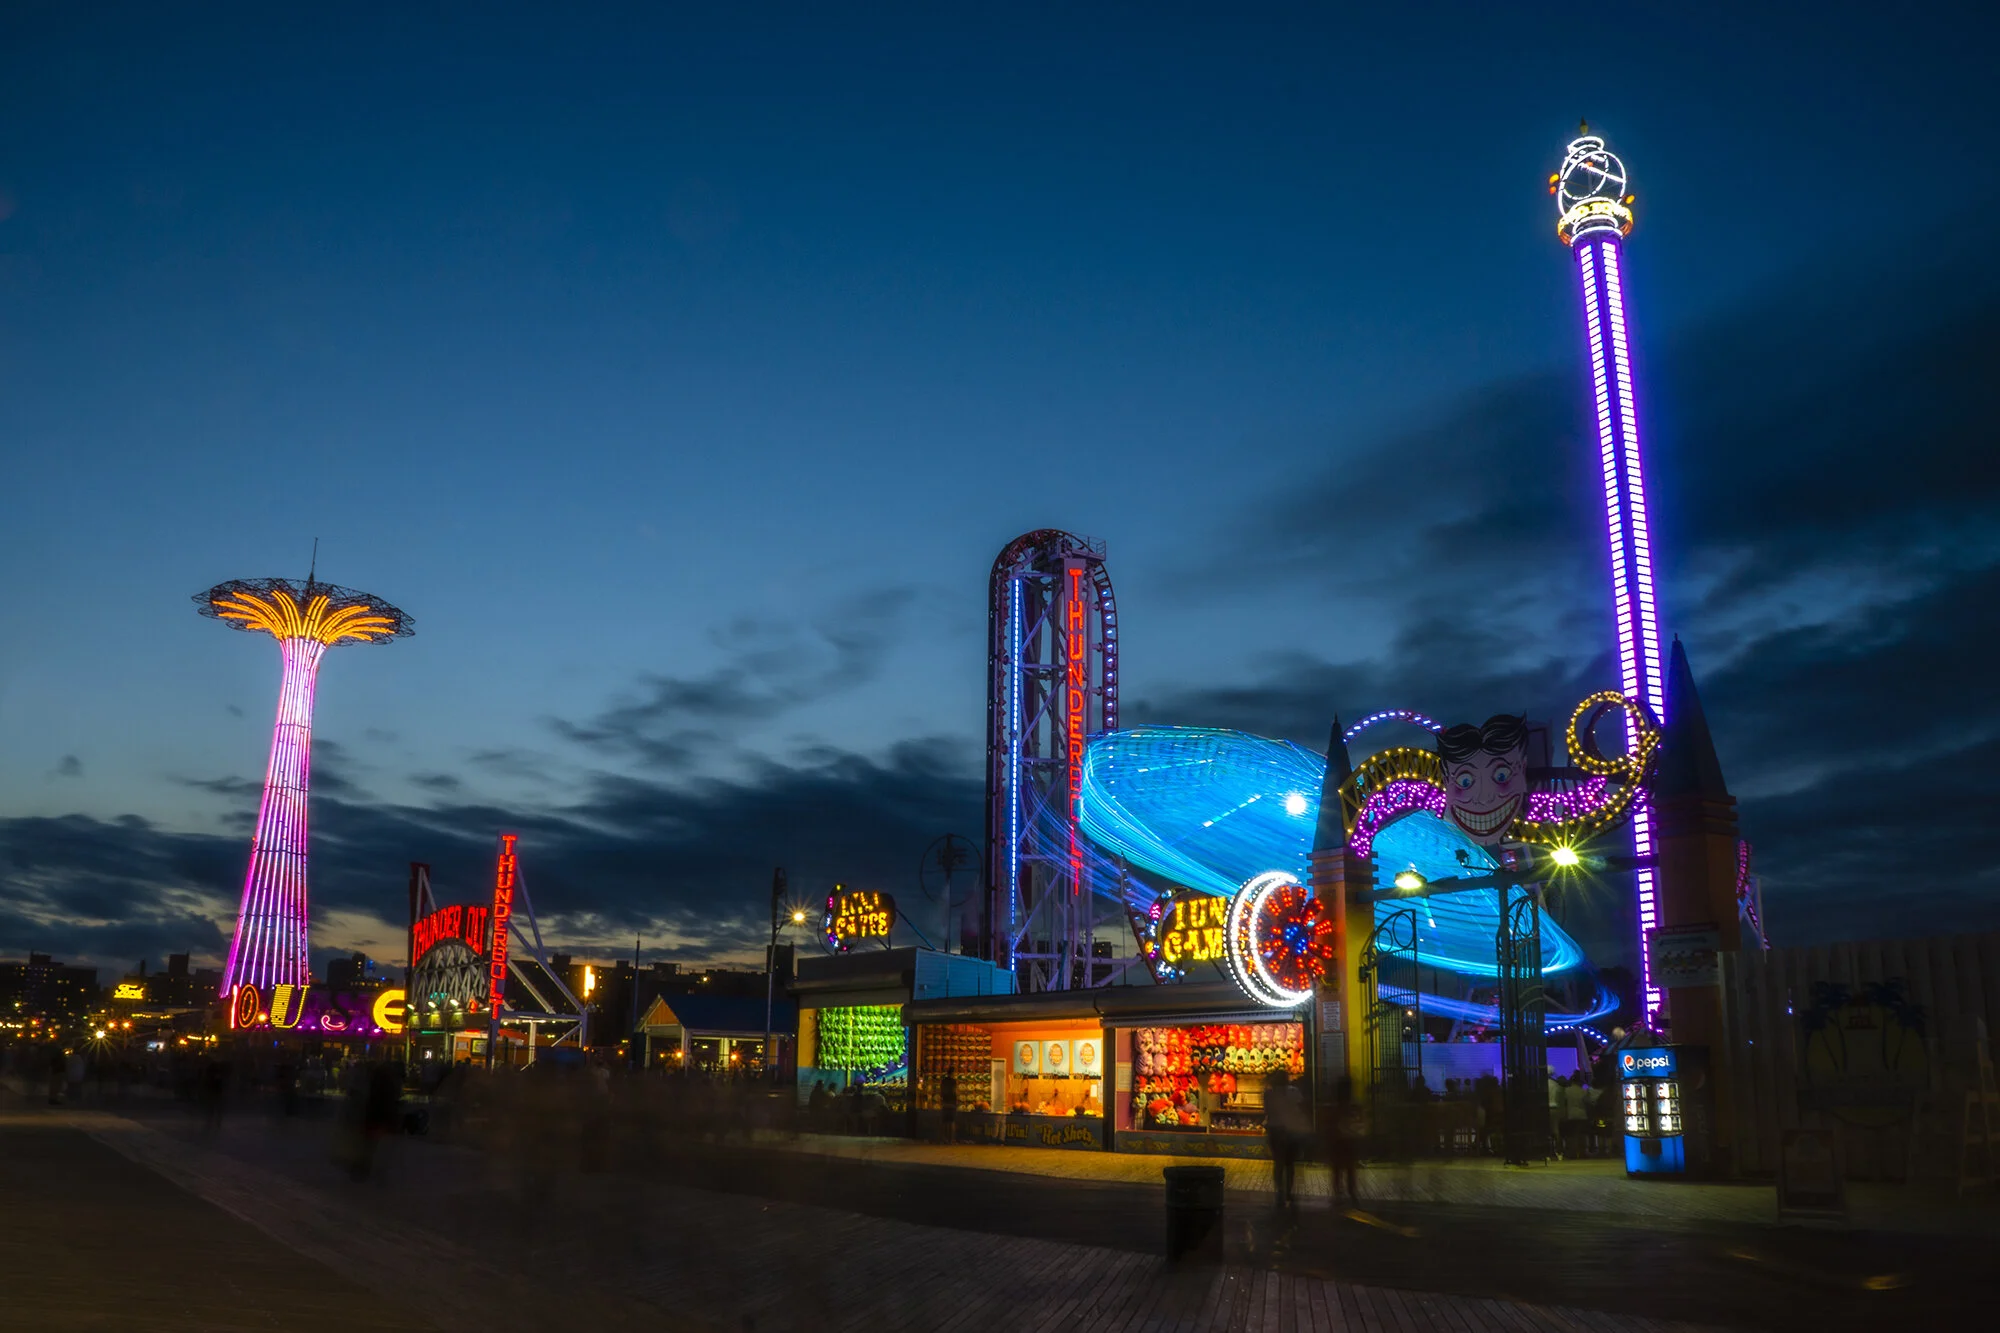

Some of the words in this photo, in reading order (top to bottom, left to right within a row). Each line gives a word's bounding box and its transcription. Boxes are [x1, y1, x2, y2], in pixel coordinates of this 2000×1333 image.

[412, 905, 488, 967] THUNDEROLT
[489, 835, 517, 1020] THUNDERBOLT
[1636, 1055, 1670, 1070] pepsi
